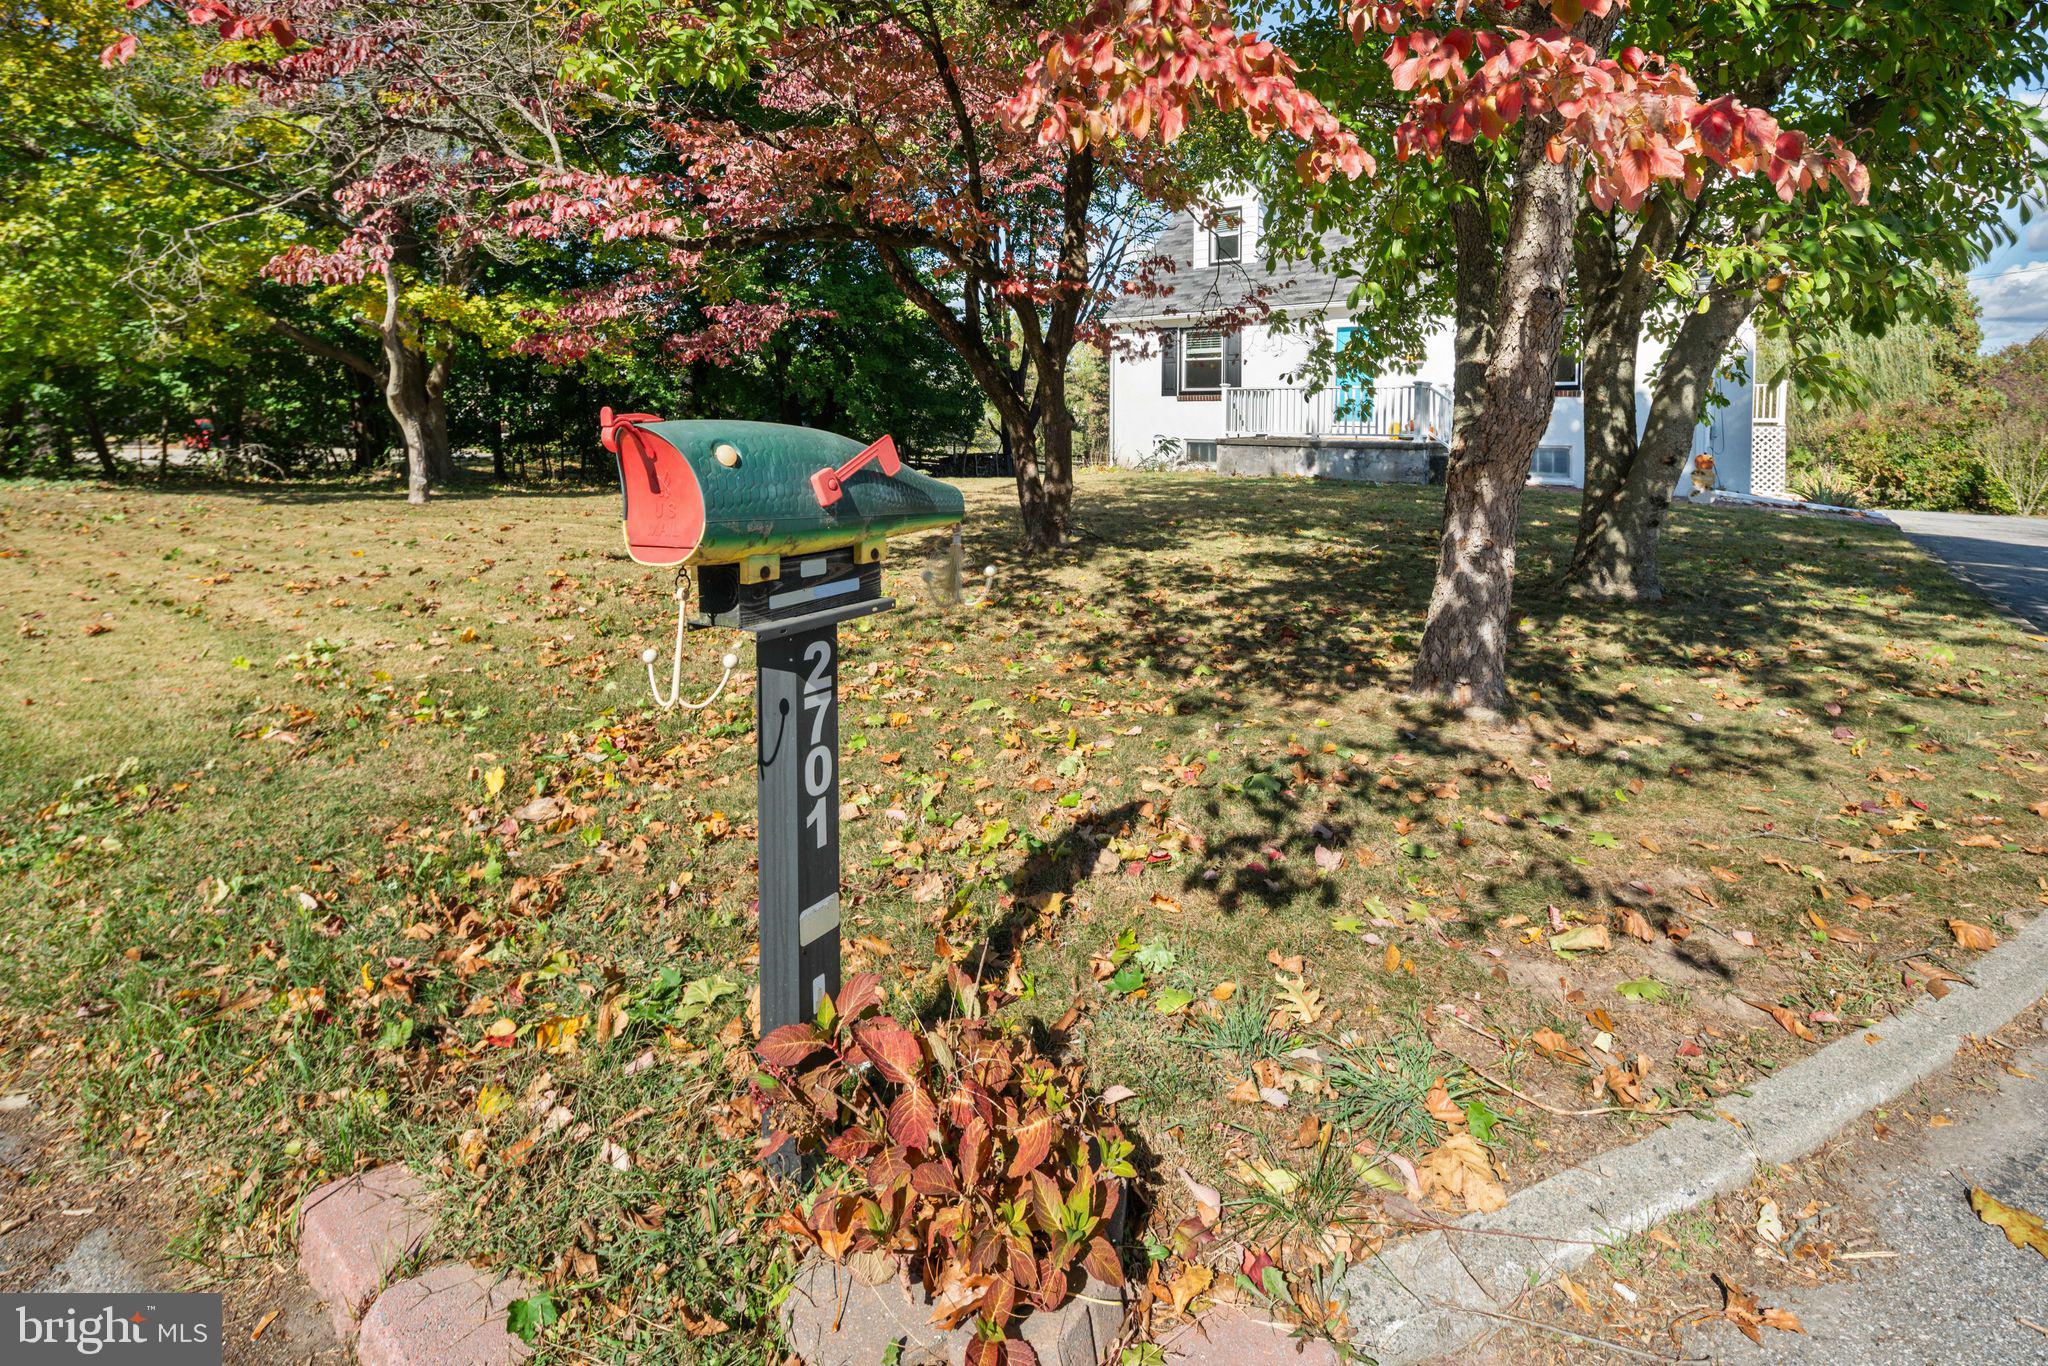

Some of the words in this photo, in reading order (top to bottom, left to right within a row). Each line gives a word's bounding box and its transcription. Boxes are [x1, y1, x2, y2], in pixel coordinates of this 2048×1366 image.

[655, 503, 677, 519] US
[648, 522, 680, 537] MAIL
[803, 640, 832, 849] 2701
